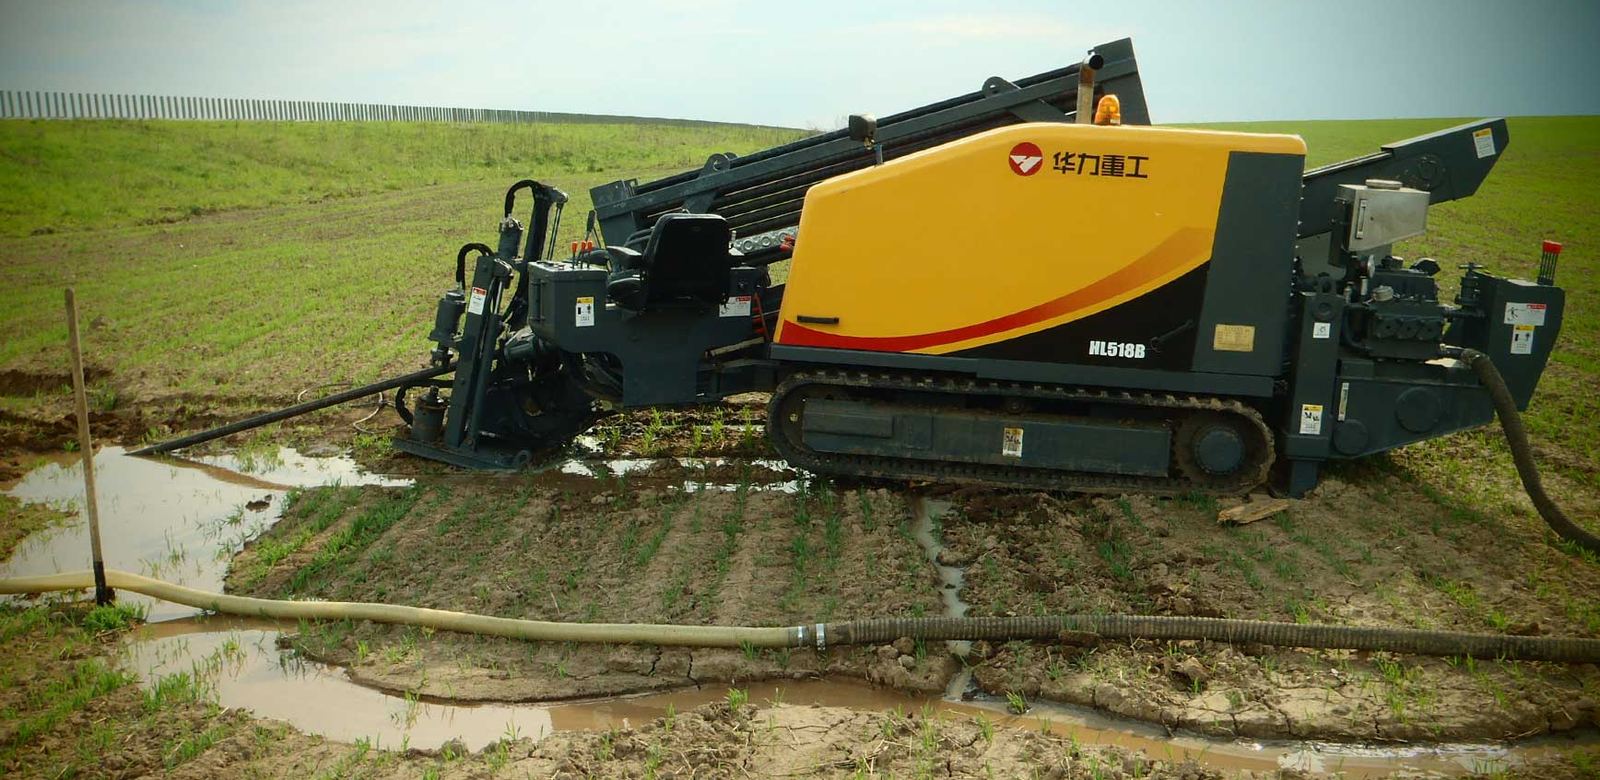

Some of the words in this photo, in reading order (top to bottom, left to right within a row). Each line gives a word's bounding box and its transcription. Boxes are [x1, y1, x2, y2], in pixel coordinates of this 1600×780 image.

[1053, 151, 1149, 178] 华力重工
[1089, 341, 1145, 358] HL518B
